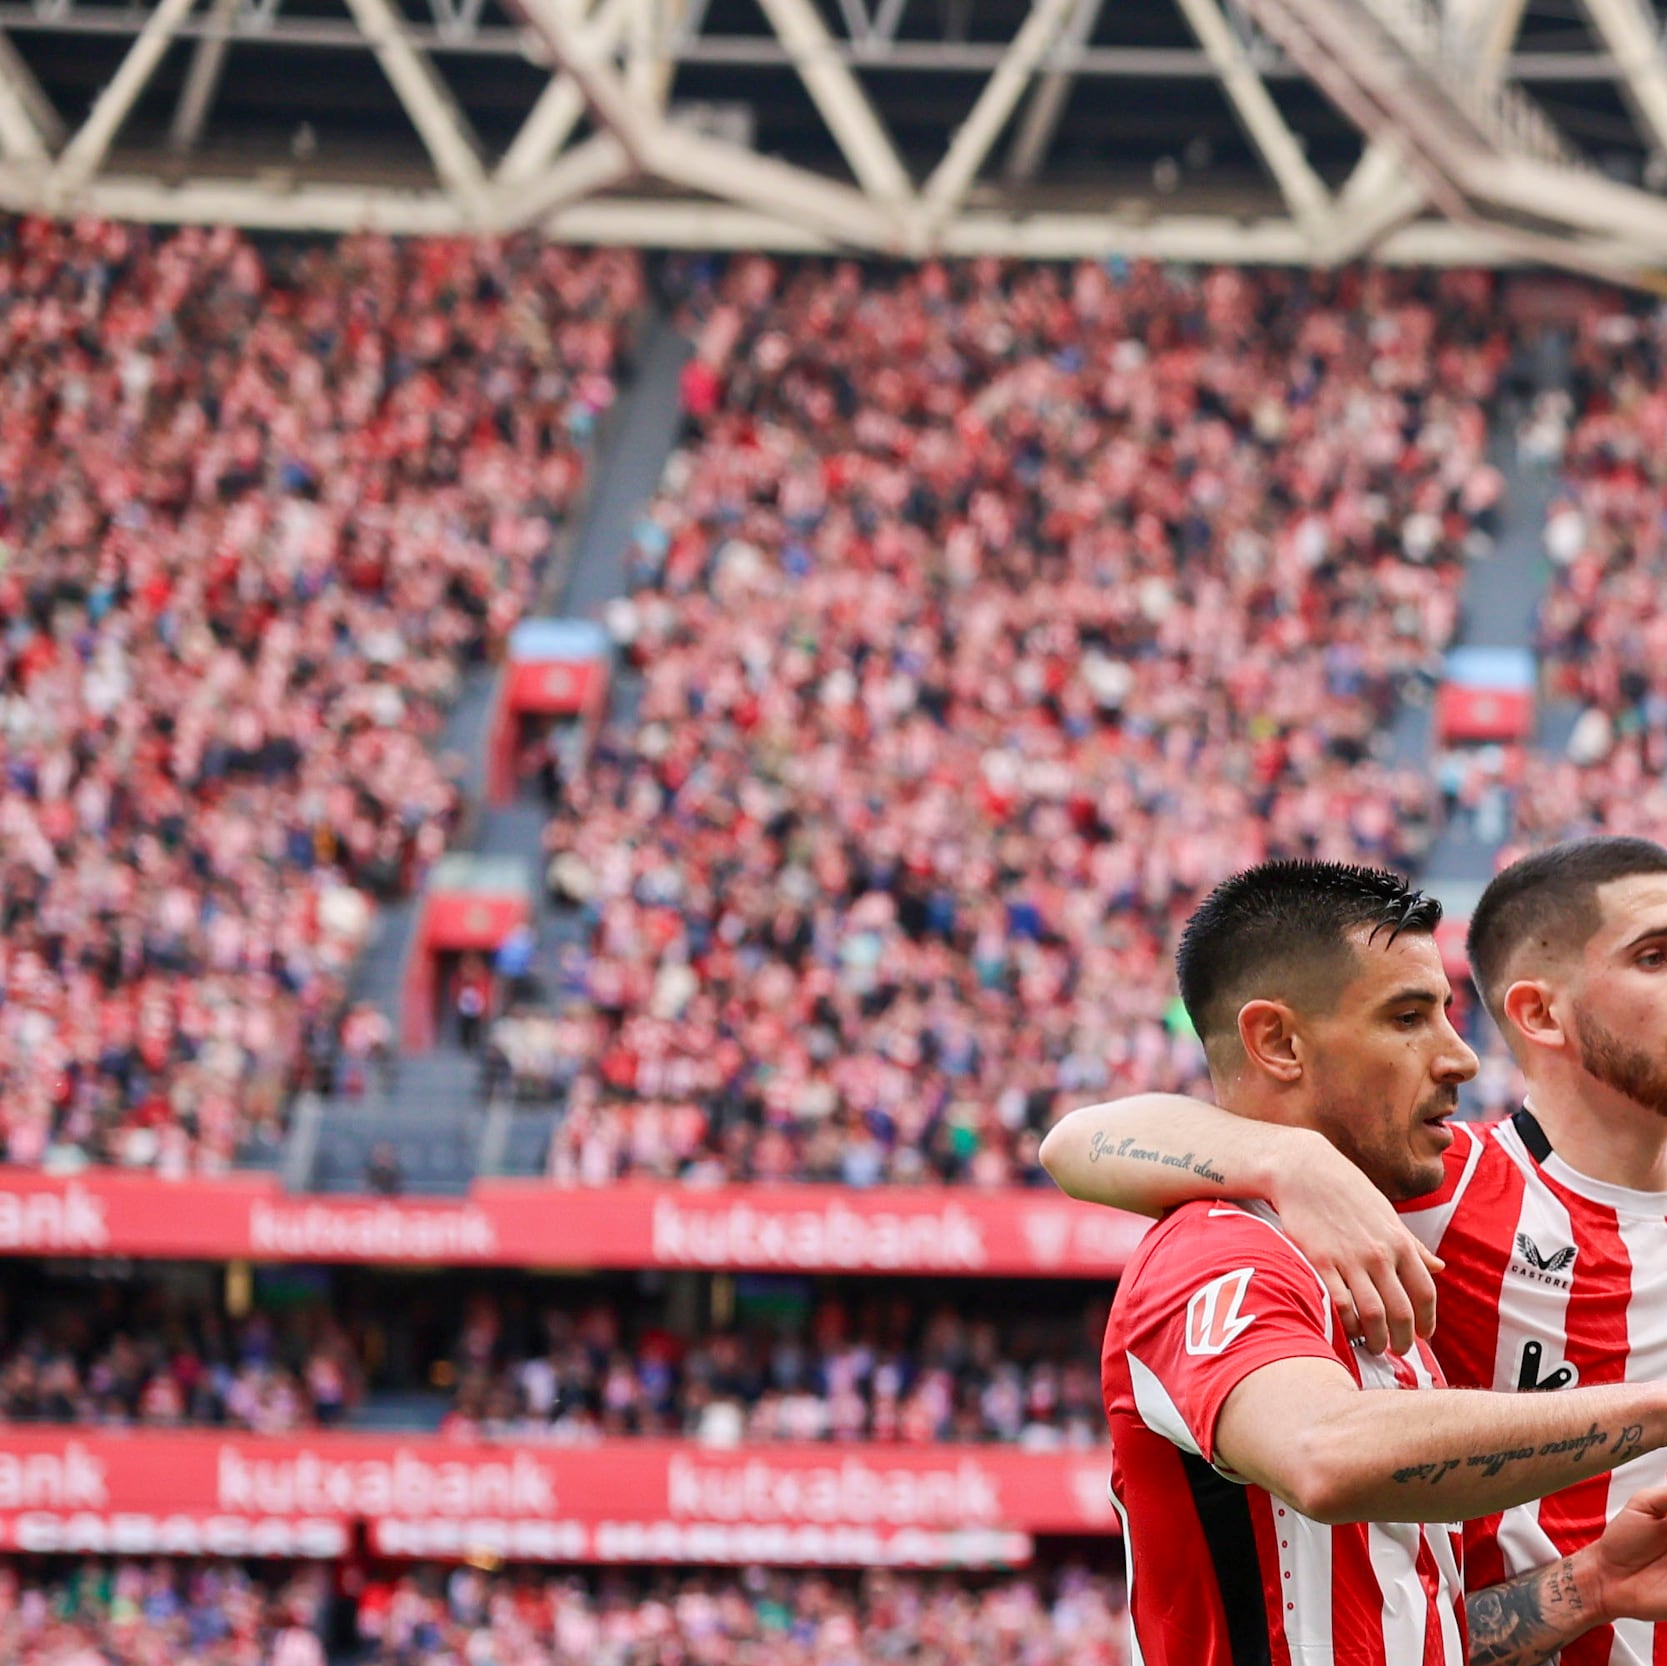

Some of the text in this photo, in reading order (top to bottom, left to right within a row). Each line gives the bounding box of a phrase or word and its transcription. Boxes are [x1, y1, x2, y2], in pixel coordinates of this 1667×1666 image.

[1128, 1147, 1160, 1163] never
[1161, 1152, 1195, 1170] walk
[1193, 1158, 1226, 1185] alone
[653, 1199, 985, 1268] kutxabank
[1511, 1264, 1569, 1290] CASTORE
[217, 1443, 558, 1516] kutxabank
